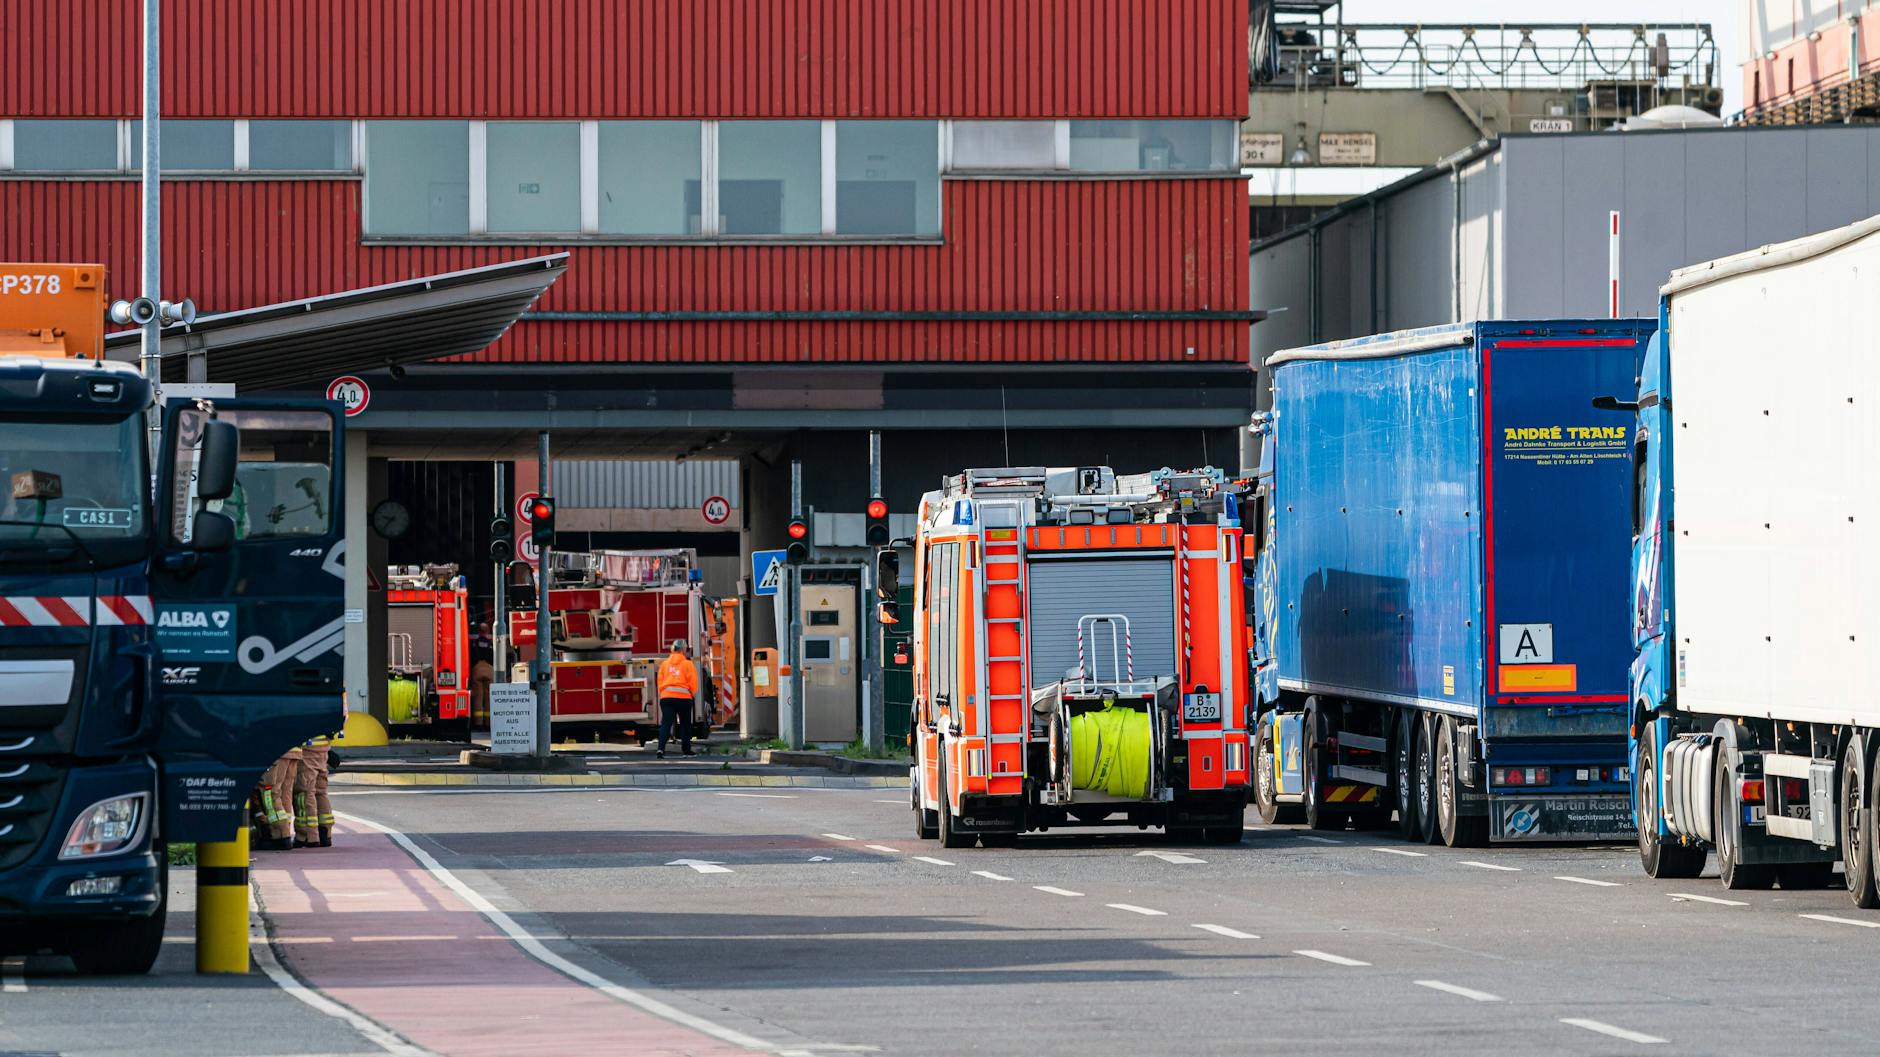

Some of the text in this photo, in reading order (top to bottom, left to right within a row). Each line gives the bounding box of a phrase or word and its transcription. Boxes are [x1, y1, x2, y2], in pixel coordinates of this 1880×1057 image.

[0, 274, 61, 295] P378
[1504, 426, 1626, 440] ANDRÉ TRANS
[1547, 440, 1576, 448] Transport
[1583, 440, 1607, 448] Logistik
[157, 611, 208, 627] ALBA
[1514, 629, 1539, 657] A
[161, 666, 202, 679] XF
[1197, 696, 1204, 706] B
[1189, 706, 1216, 717] 2139
[186, 777, 236, 787] DAF Berlin
[1545, 799, 1630, 811] Martin Reisch
